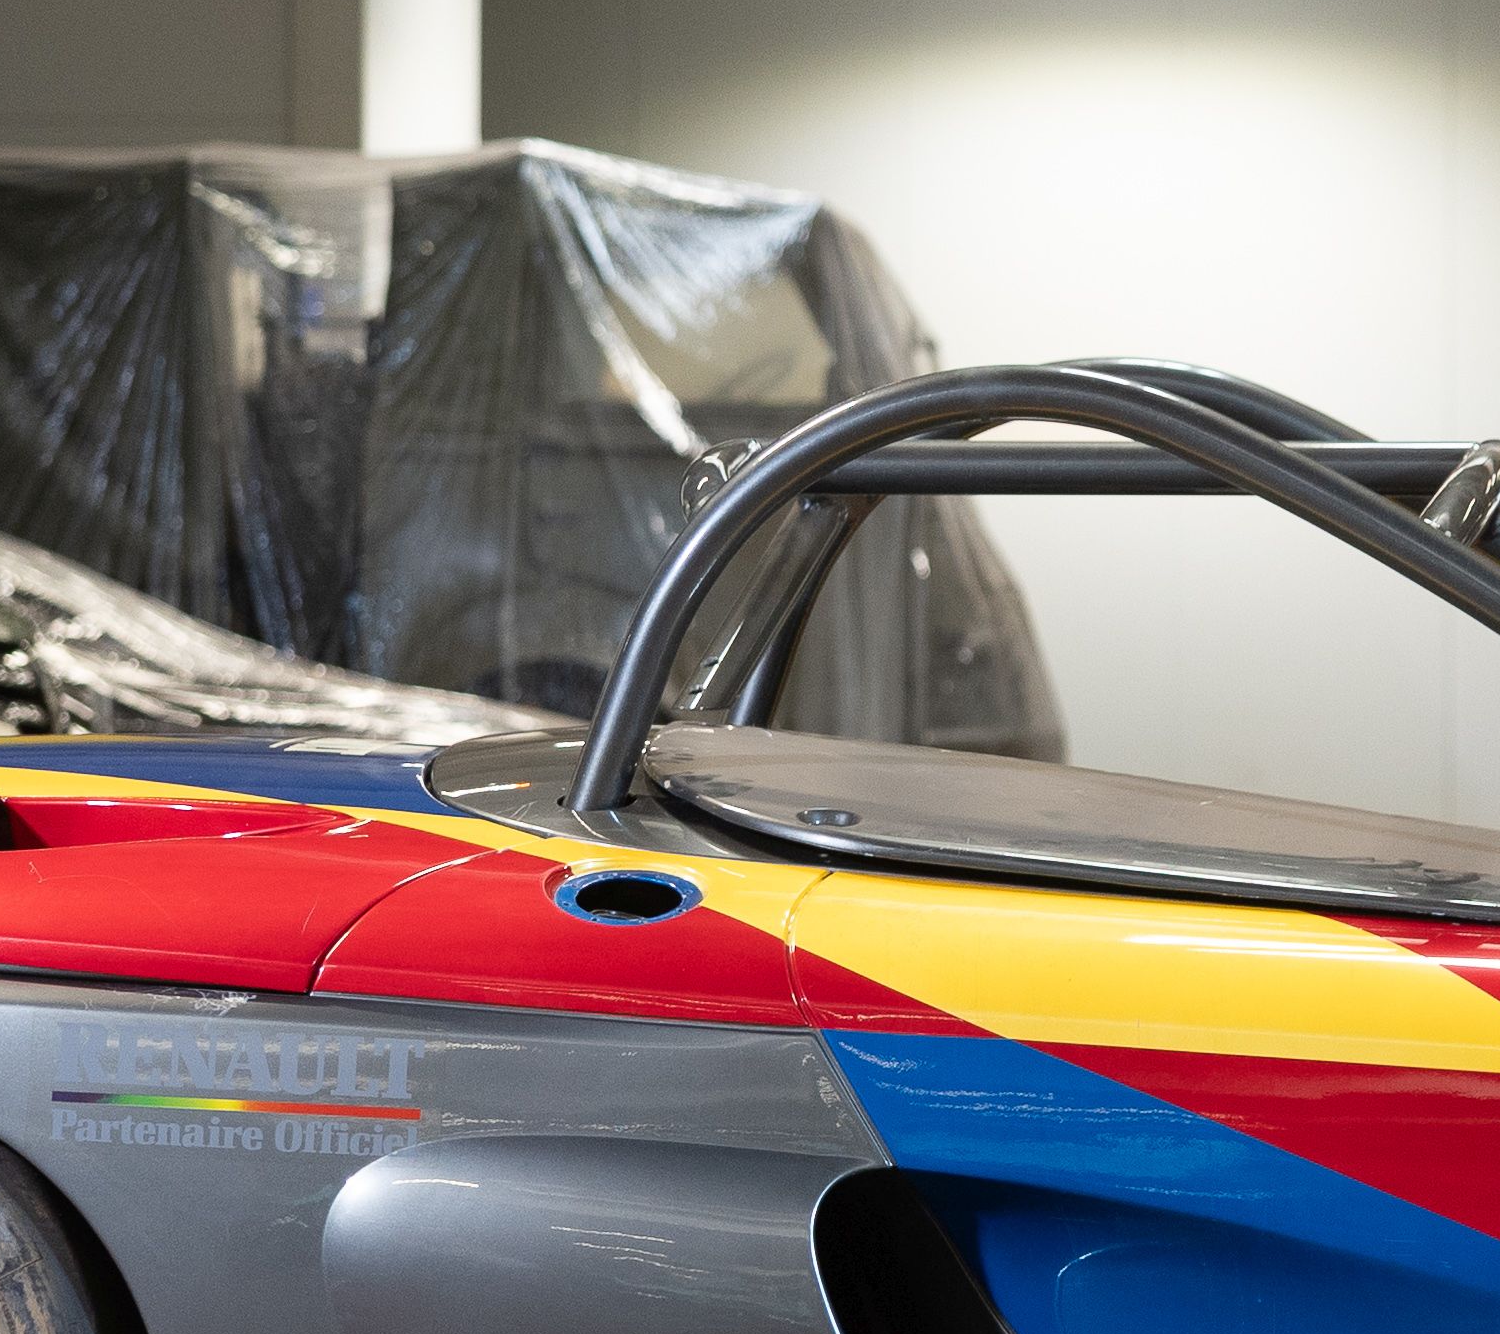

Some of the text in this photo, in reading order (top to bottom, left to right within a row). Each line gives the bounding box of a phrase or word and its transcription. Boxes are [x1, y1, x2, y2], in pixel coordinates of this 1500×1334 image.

[54, 1022, 426, 1100] RENAULT
[49, 1107, 418, 1159] Partenaire Officiel
